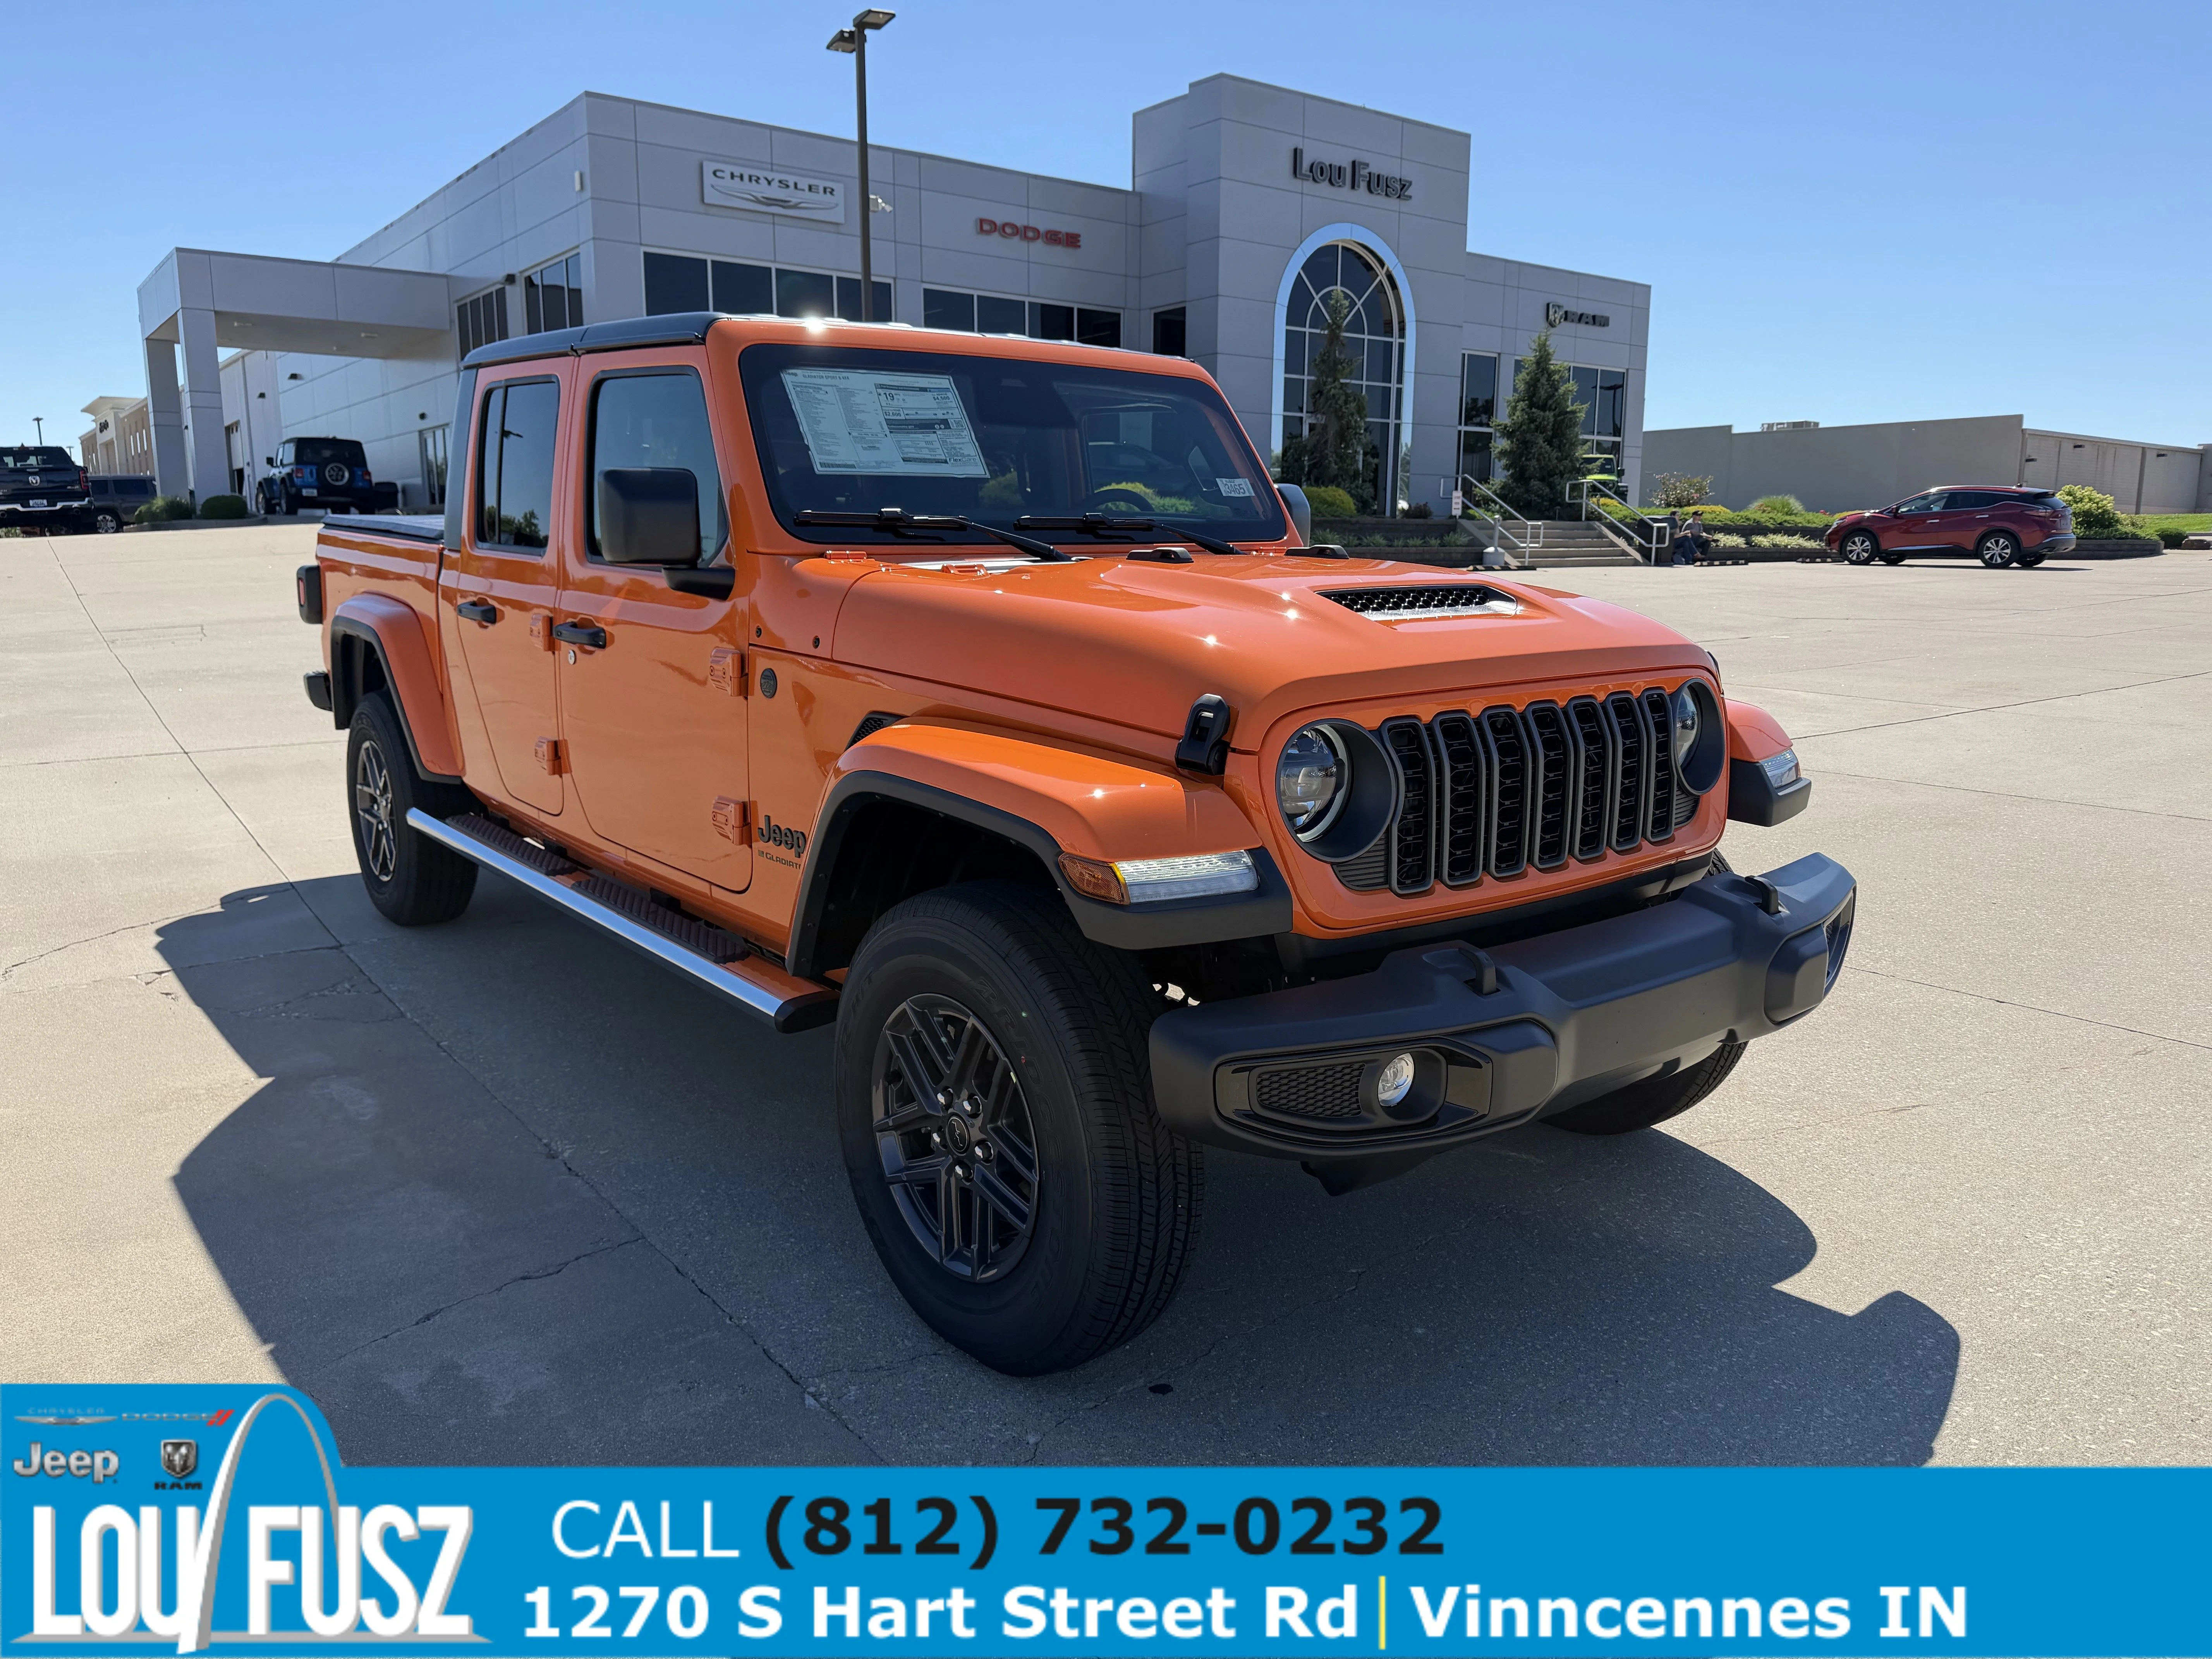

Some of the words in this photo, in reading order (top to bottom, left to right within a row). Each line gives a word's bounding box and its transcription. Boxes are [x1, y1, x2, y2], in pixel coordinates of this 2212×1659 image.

[712, 168, 835, 196] CHRYSLER
[1293, 147, 1346, 187] Lou
[1351, 159, 1412, 201] Fusz
[976, 218, 1081, 248] DODGE
[1564, 310, 1609, 327] RAM
[883, 392, 895, 401] 19
[1224, 483, 1246, 495] 3465
[757, 815, 807, 858] Jeep
[972, 975, 1066, 1312] BRIDGESTONE
